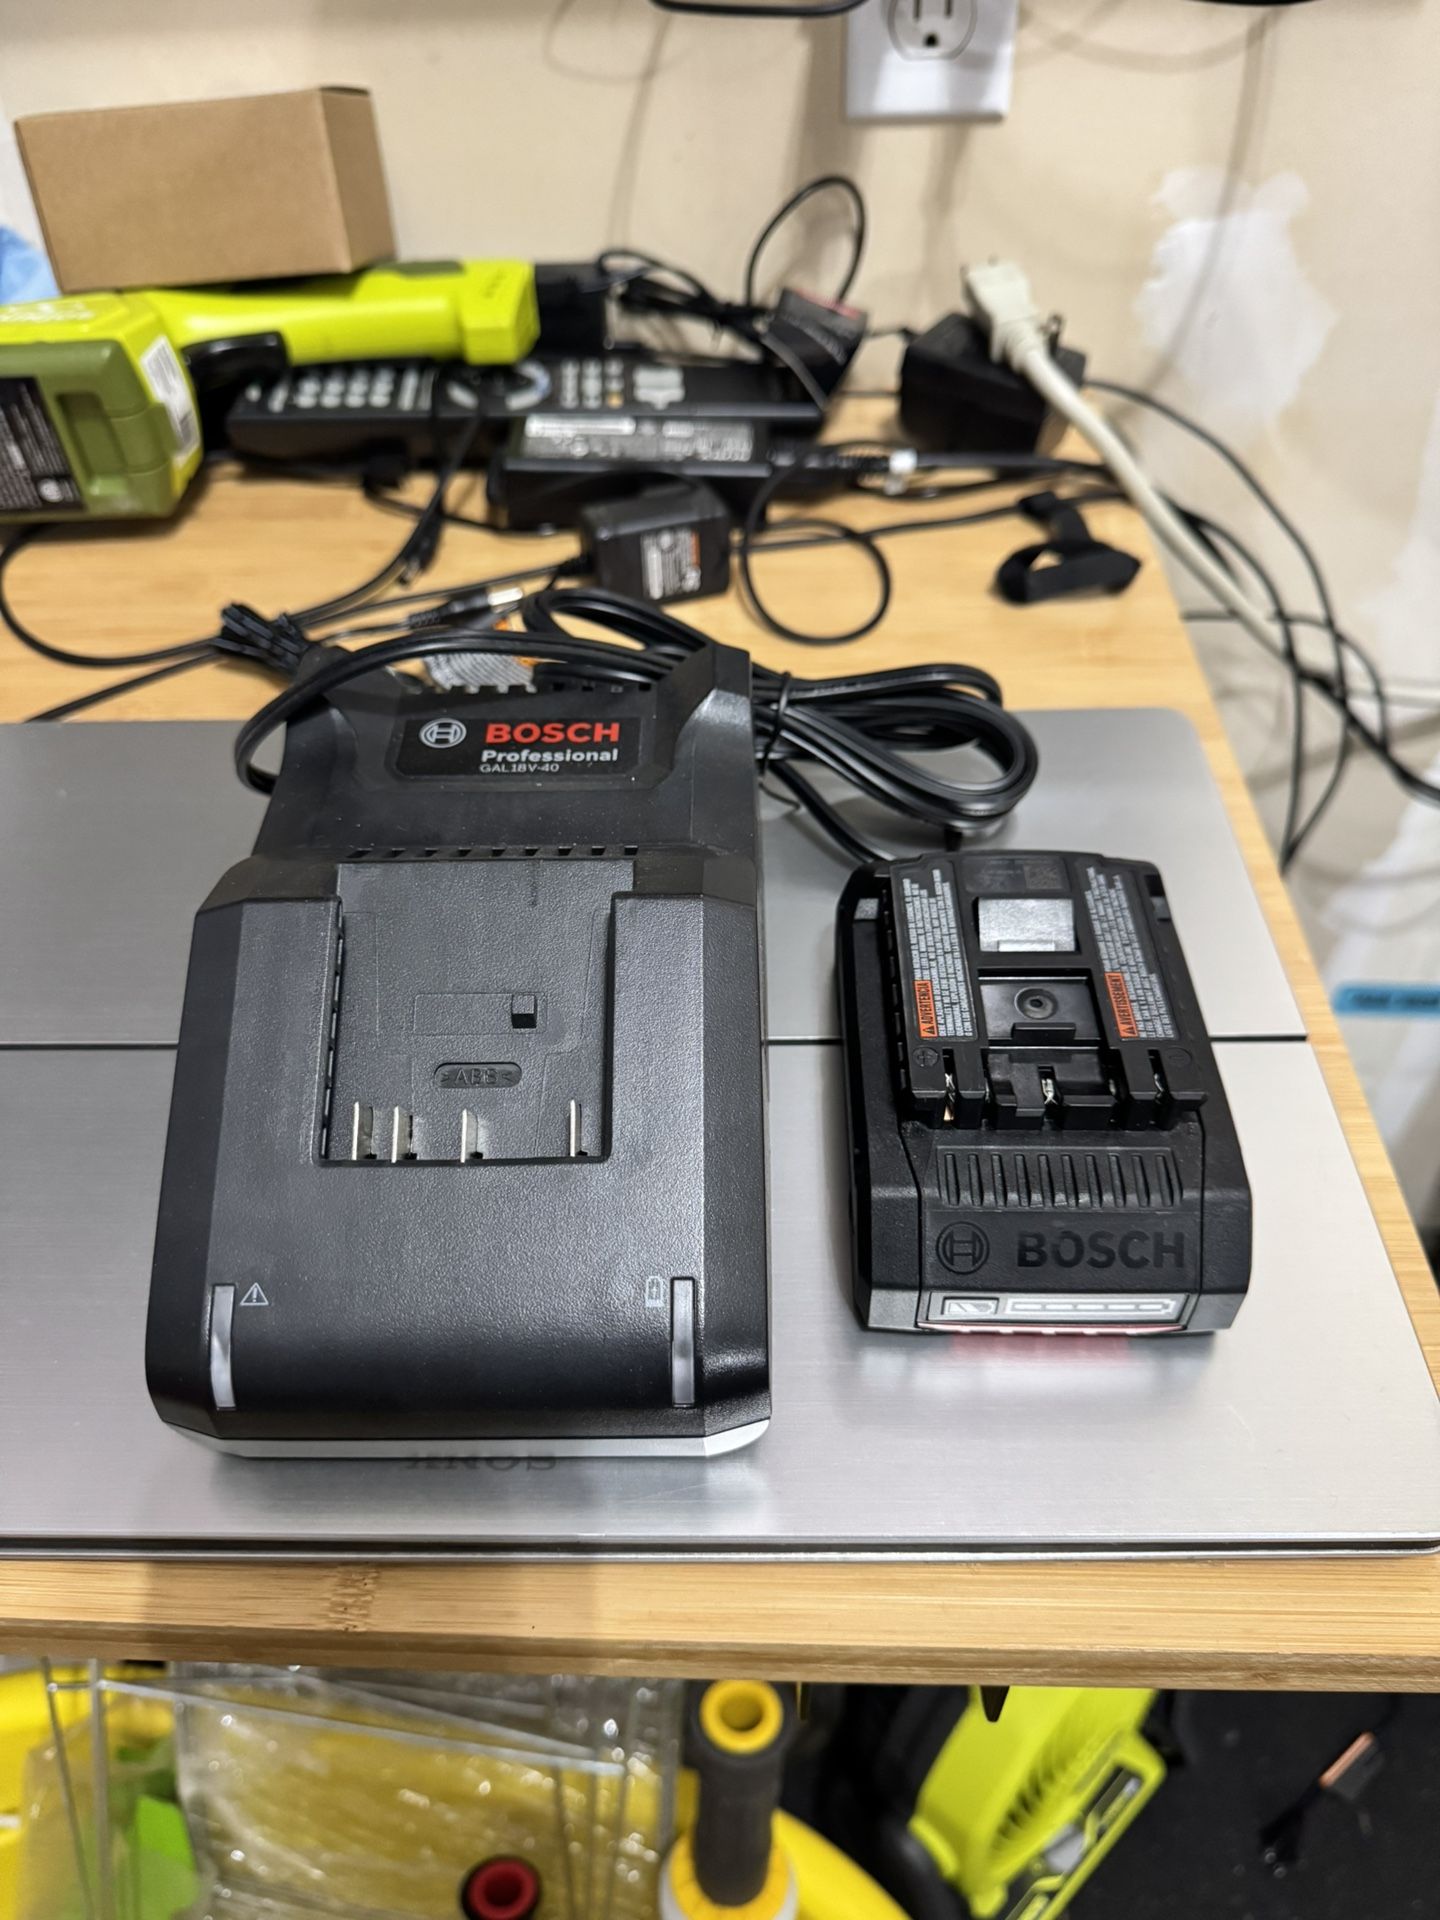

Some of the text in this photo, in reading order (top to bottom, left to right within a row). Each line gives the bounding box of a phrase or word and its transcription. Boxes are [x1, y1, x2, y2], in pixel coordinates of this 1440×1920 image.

[485, 722, 620, 743] BOSCH
[481, 748, 618, 762] Professional
[917, 982, 934, 1024] ADVERTENCIA
[1108, 974, 1133, 1025] AVERTISSEMENT
[1017, 1230, 1185, 1268] BOSCH
